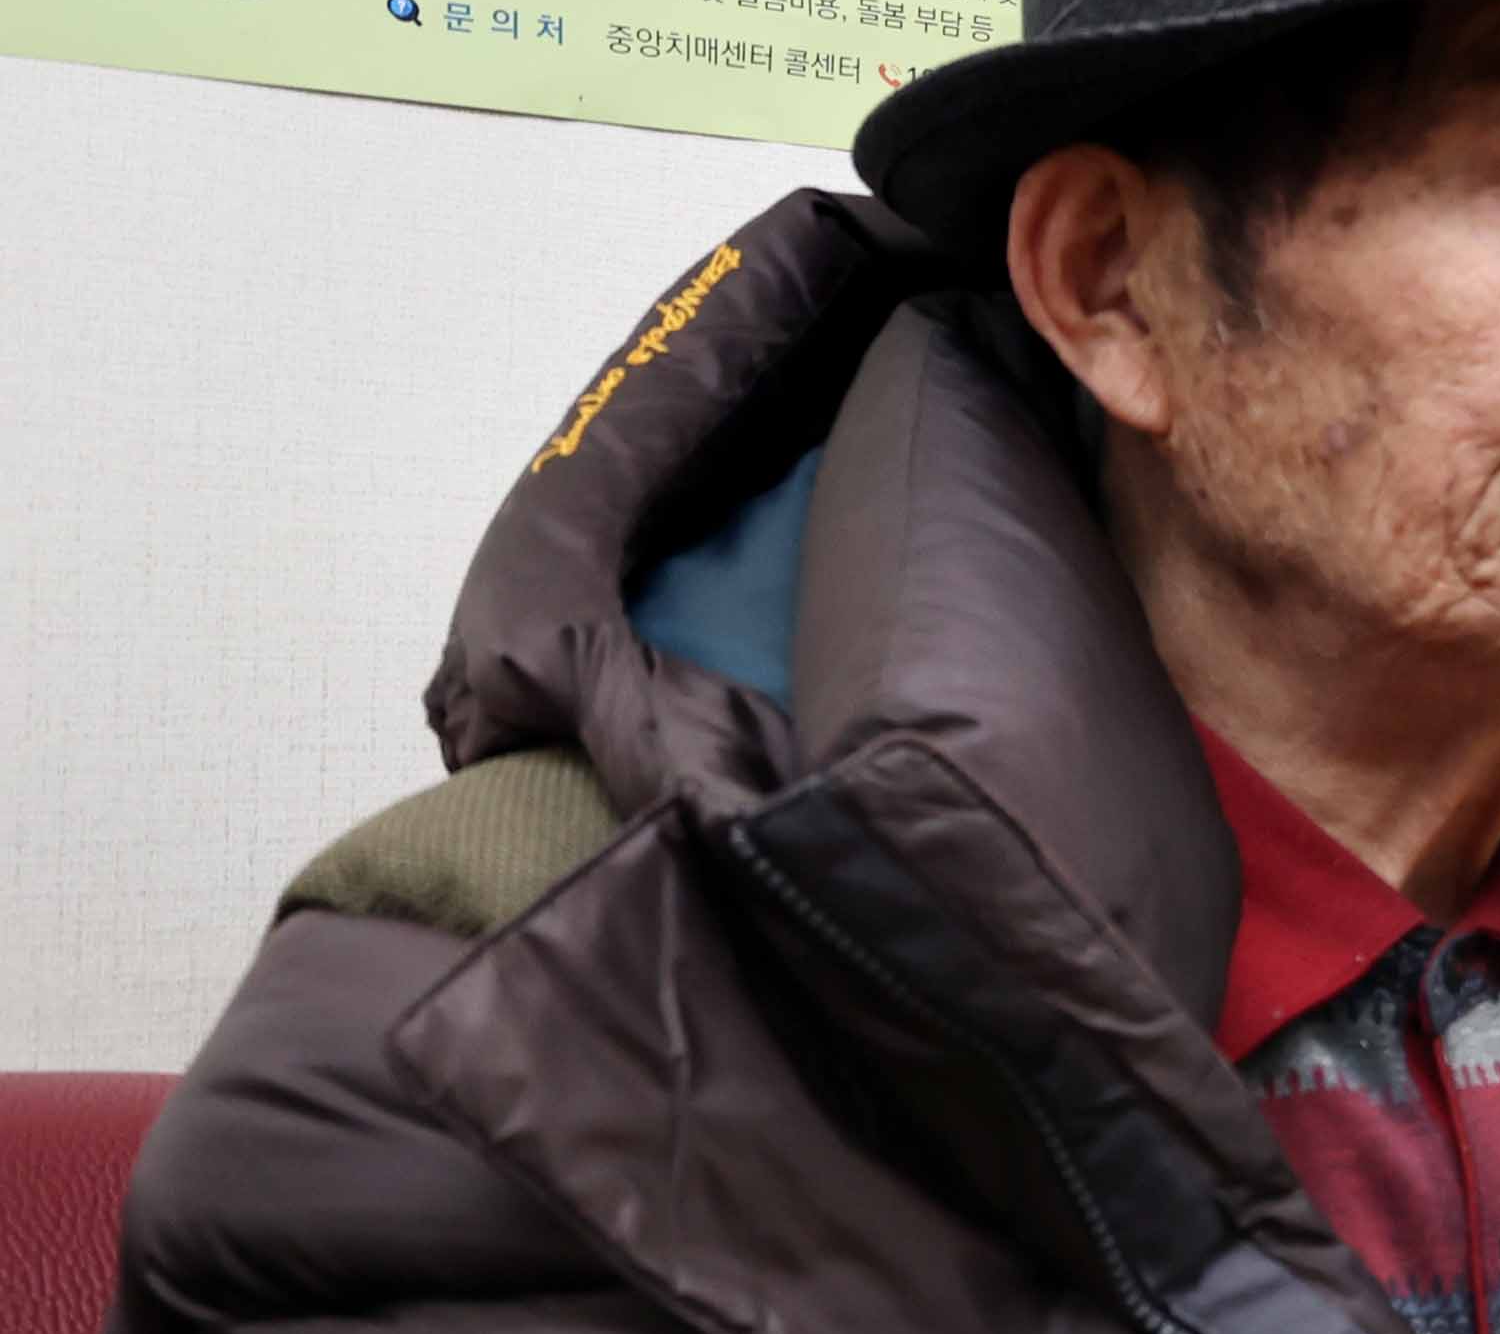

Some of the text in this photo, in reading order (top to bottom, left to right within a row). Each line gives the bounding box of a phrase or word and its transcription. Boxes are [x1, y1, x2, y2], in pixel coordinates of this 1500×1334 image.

[914, 6, 963, 39] 부담
[970, 14, 994, 44] 등
[606, 24, 862, 84] 중앙치매센터 콜센터
